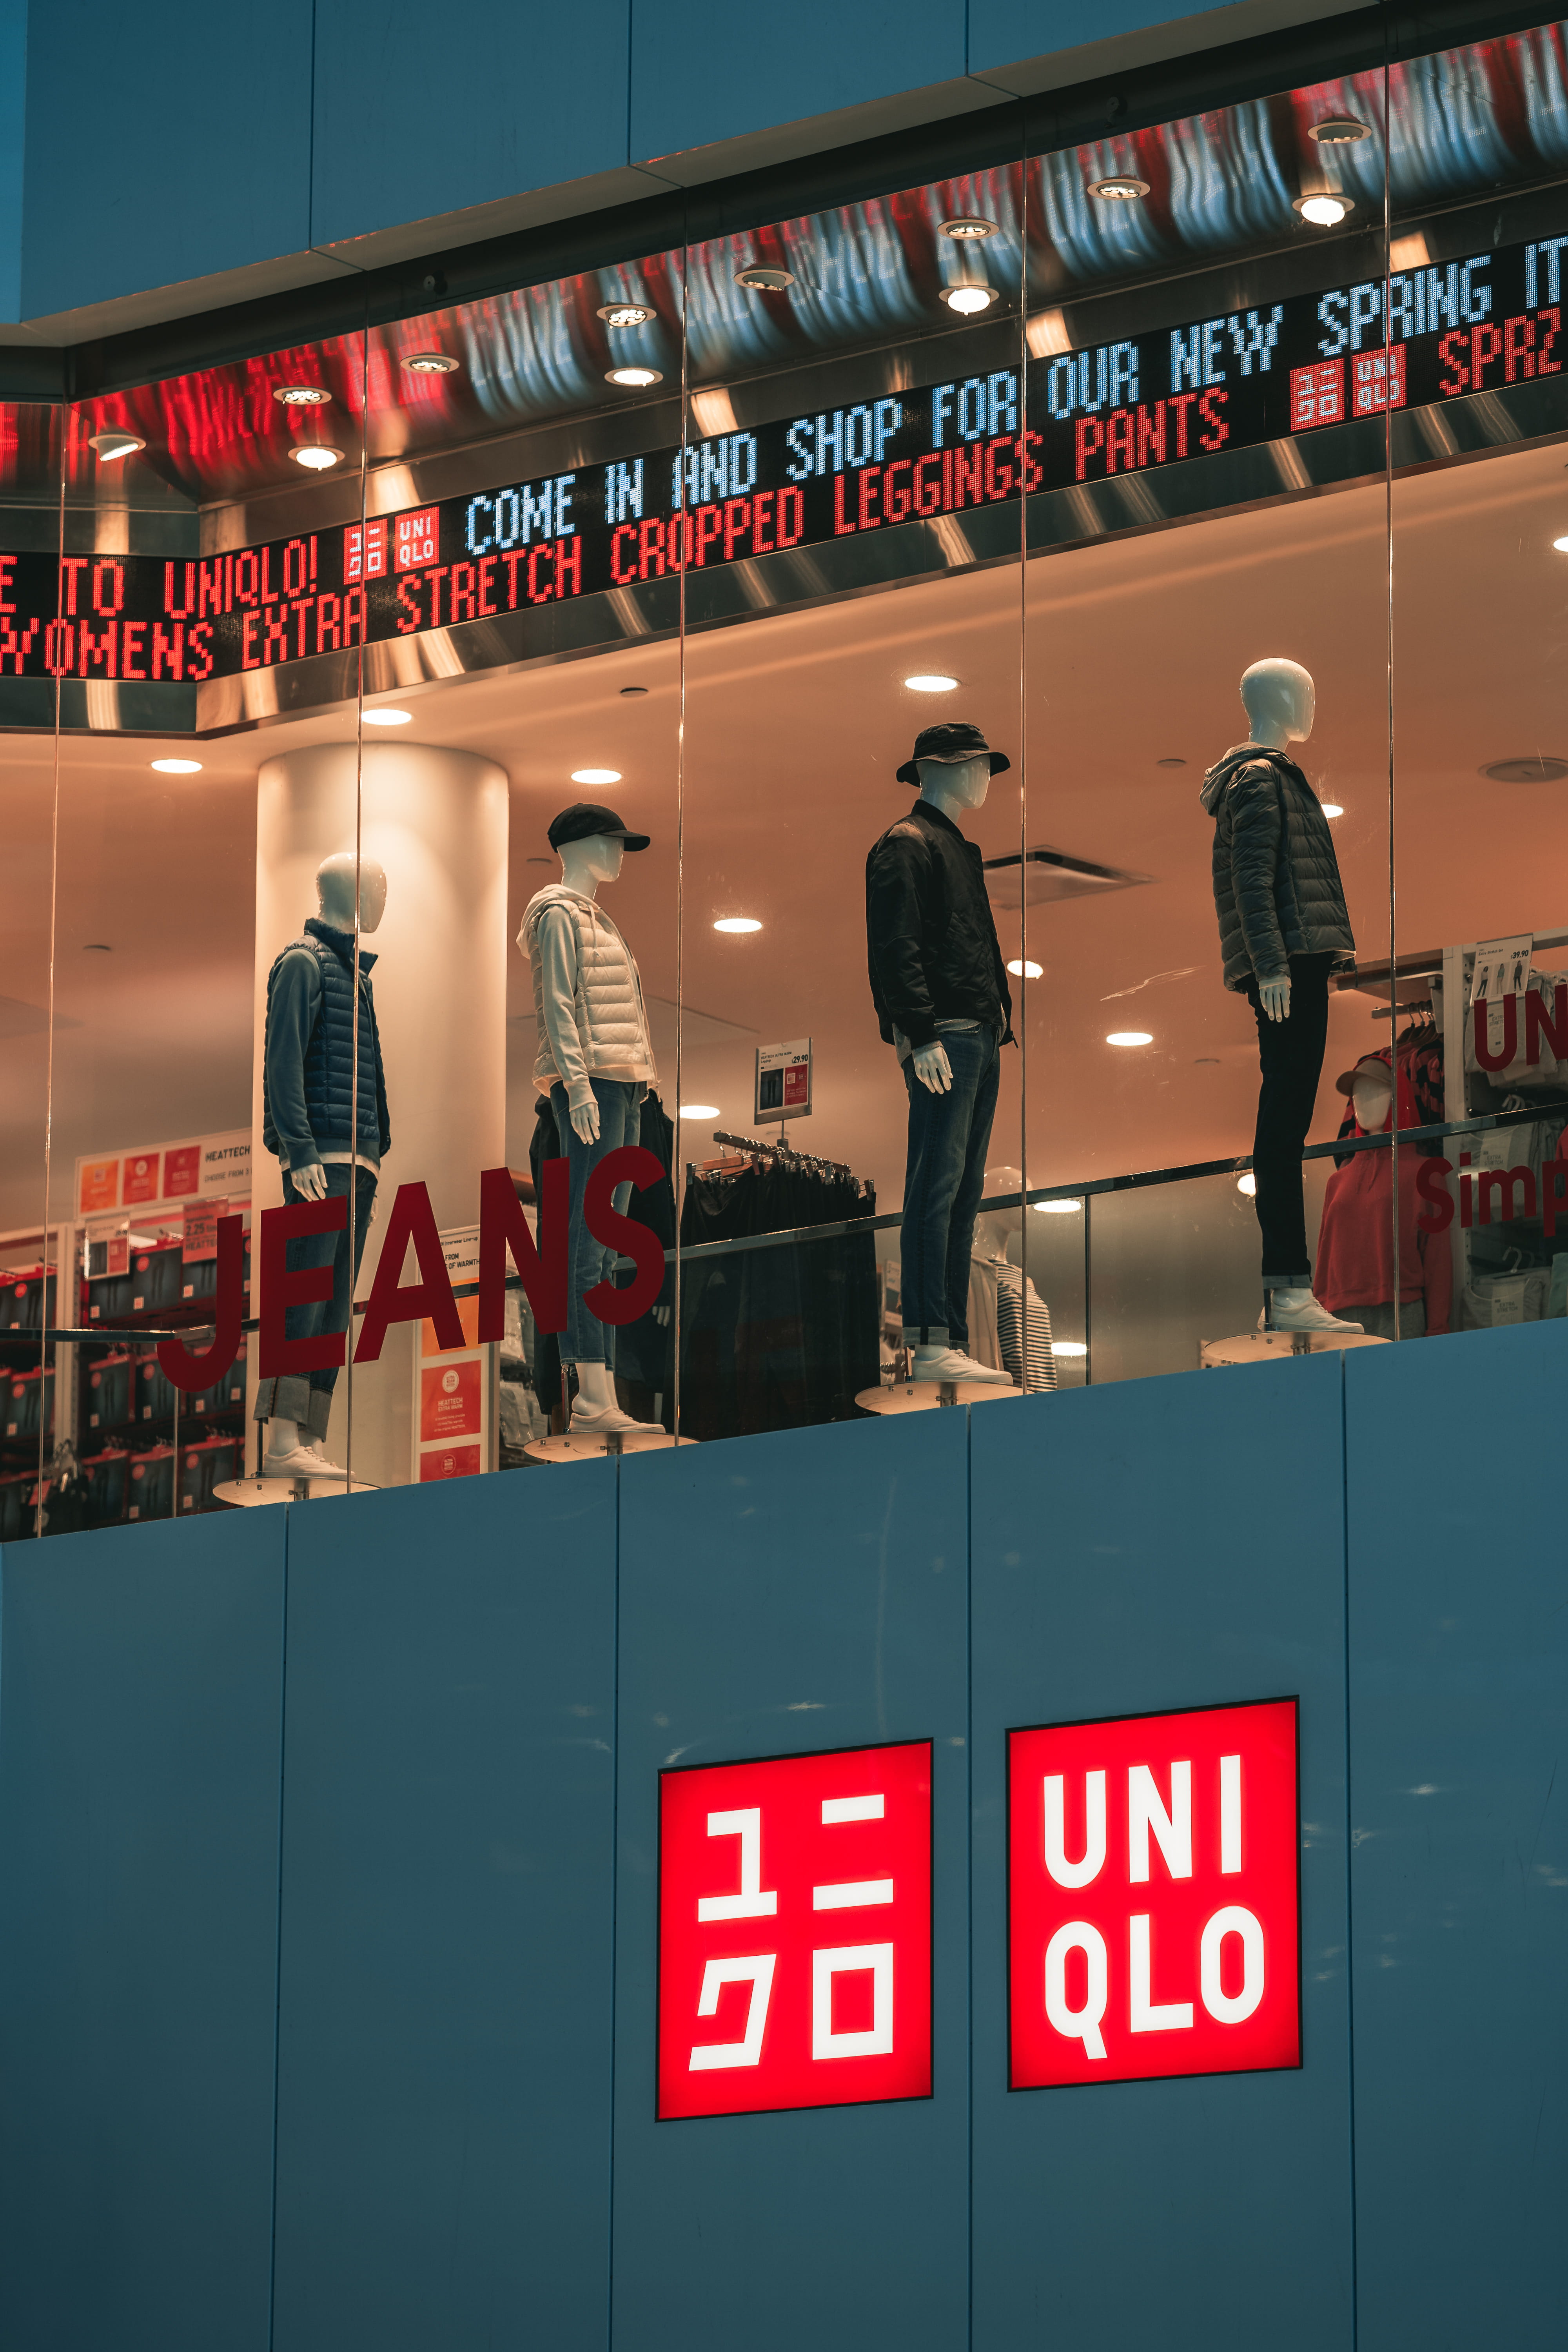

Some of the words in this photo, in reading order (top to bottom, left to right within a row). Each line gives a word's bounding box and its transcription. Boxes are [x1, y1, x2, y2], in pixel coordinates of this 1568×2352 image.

[1439, 307, 1562, 396] SPRZ
[465, 474, 575, 555] COME
[605, 458, 643, 524] IN
[672, 432, 757, 508] AND
[786, 398, 902, 481] SHOP
[933, 371, 1017, 448] FOR
[1048, 341, 1139, 420] OUR
[1171, 305, 1283, 392] NEW
[1318, 255, 1492, 356] SPRING
[1525, 236, 1568, 309] IT
[242, 587, 367, 670] EXTRA
[396, 536, 582, 634] STRETCH
[610, 485, 804, 584] CROPPED
[835, 430, 1044, 535] LEGGINGS
[1076, 387, 1229, 481] PANTS
[400, 516, 431, 541] UNI
[400, 539, 434, 567] QLO
[62, 558, 125, 617] TO
[164, 535, 318, 619] UNIQLO!
[1511, 950, 1528, 959] $39.90
[791, 1054, 808, 1063] $29.90
[1474, 983, 1568, 1072] UN
[205, 1145, 250, 1163] HEATTECH
[1416, 1152, 1568, 1237] Simp
[157, 1145, 666, 1393] JEANS
[457, 1258, 480, 1268] WARMTH
[438, 1397, 463, 1406] HEATTECH
[1044, 1755, 1242, 1889] UNI
[1044, 1906, 1265, 2060] QLO
